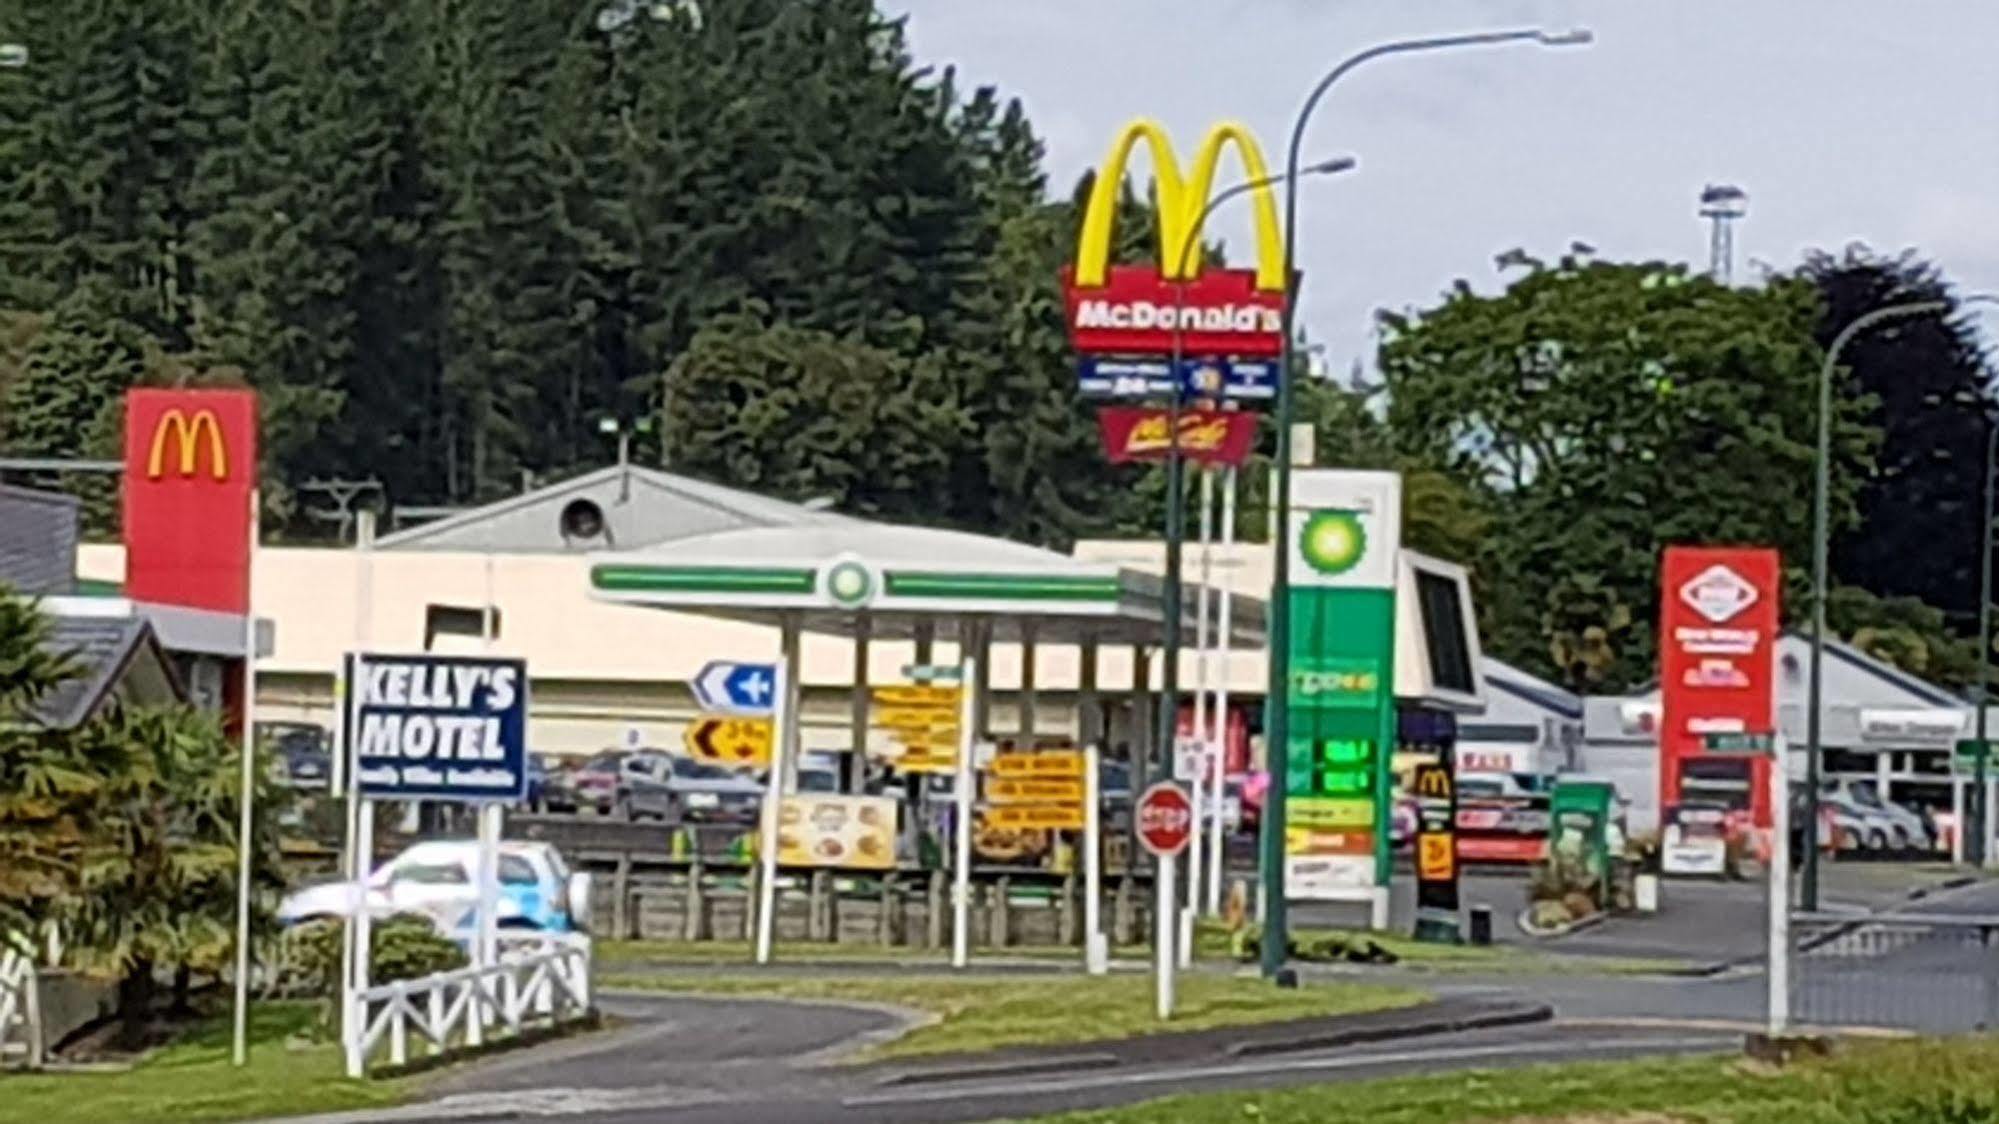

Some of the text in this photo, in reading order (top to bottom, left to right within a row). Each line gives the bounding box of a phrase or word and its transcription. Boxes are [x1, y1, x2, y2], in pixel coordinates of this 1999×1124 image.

[1075, 300, 1282, 331] McDonald's
[357, 664, 517, 711] KELLY'S
[360, 713, 505, 760] MOTEL
